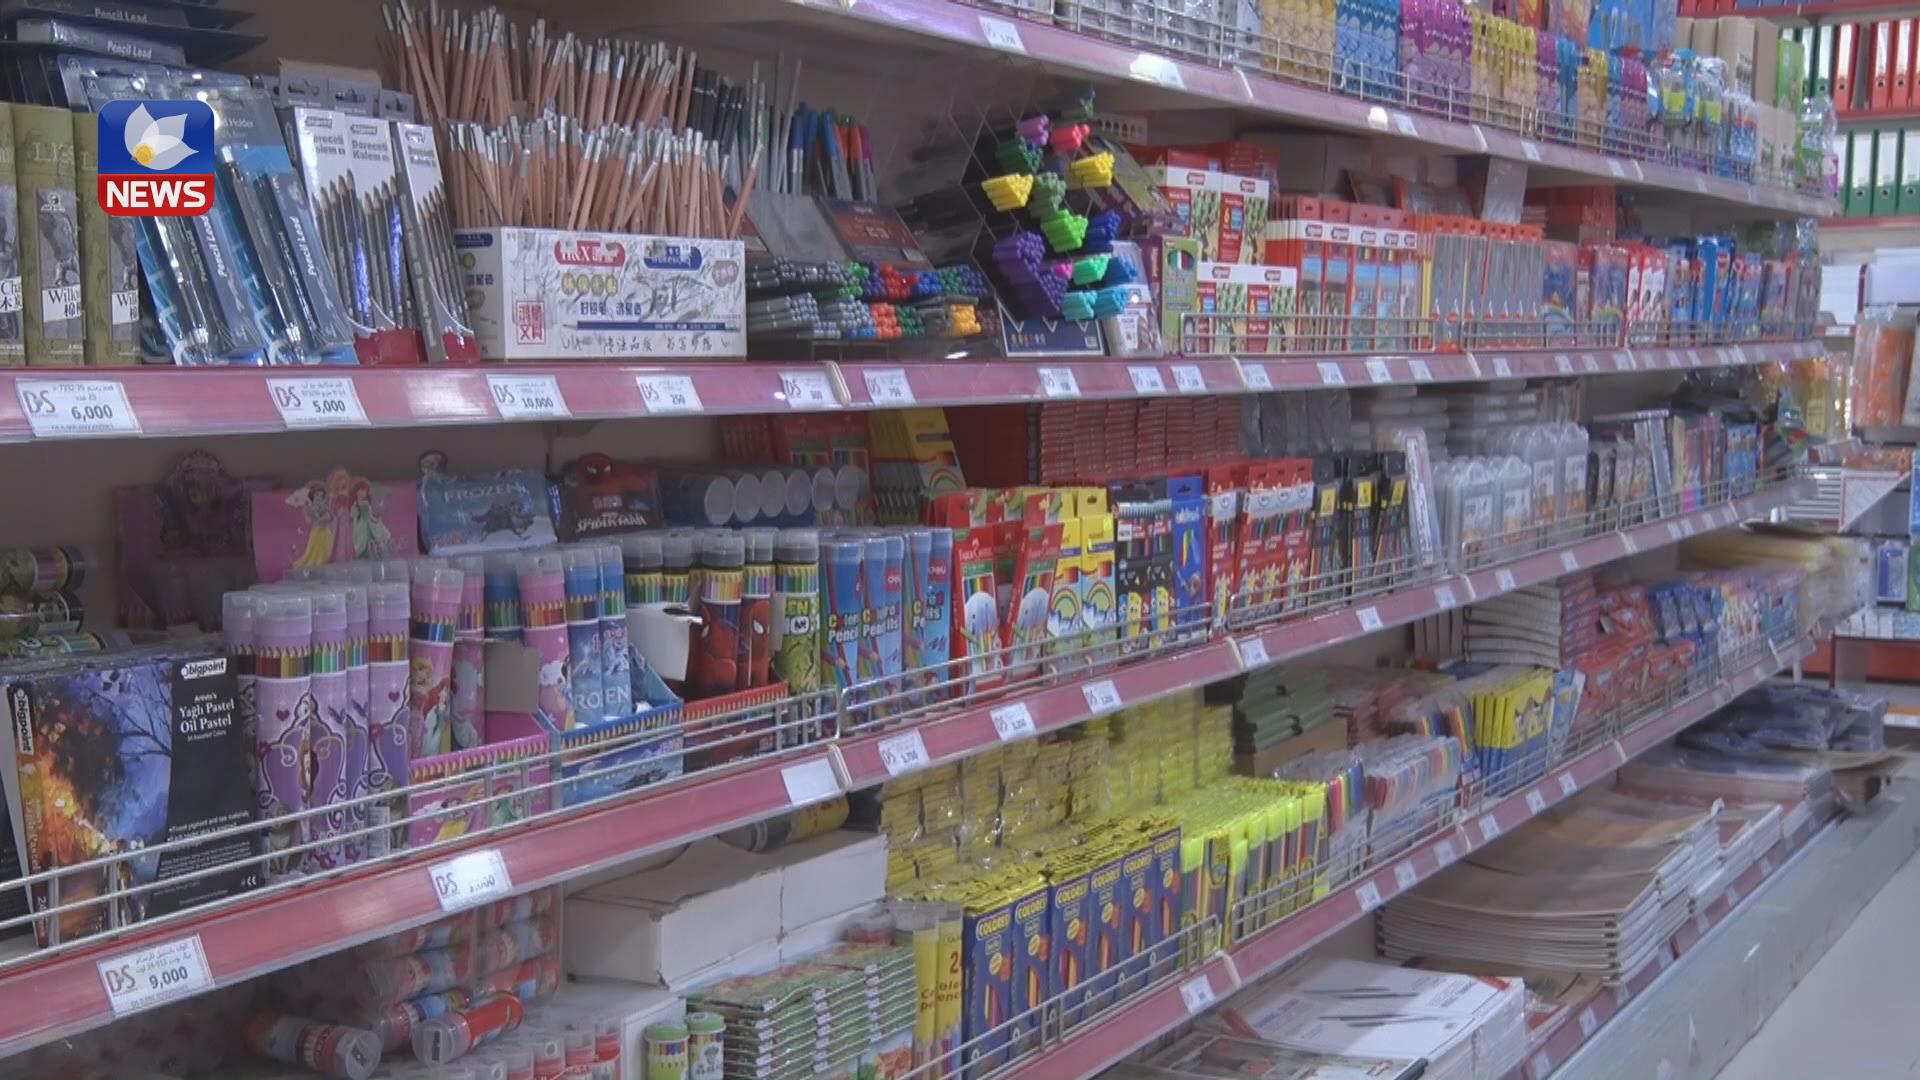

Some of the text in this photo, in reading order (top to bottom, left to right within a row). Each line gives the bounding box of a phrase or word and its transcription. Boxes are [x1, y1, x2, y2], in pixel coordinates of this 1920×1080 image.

[95, 8, 148, 24] Pencil Lead
[107, 40, 152, 58] Pencil Lead
[312, 400, 346, 415] 5,000
[521, 396, 555, 409] 10,000
[71, 404, 113, 422] 6,000
[206, 698, 235, 713] Pastel
[17, 700, 32, 752] bigpoint
[180, 713, 231, 733] Oil Pastel
[149, 966, 188, 989] 9,000
